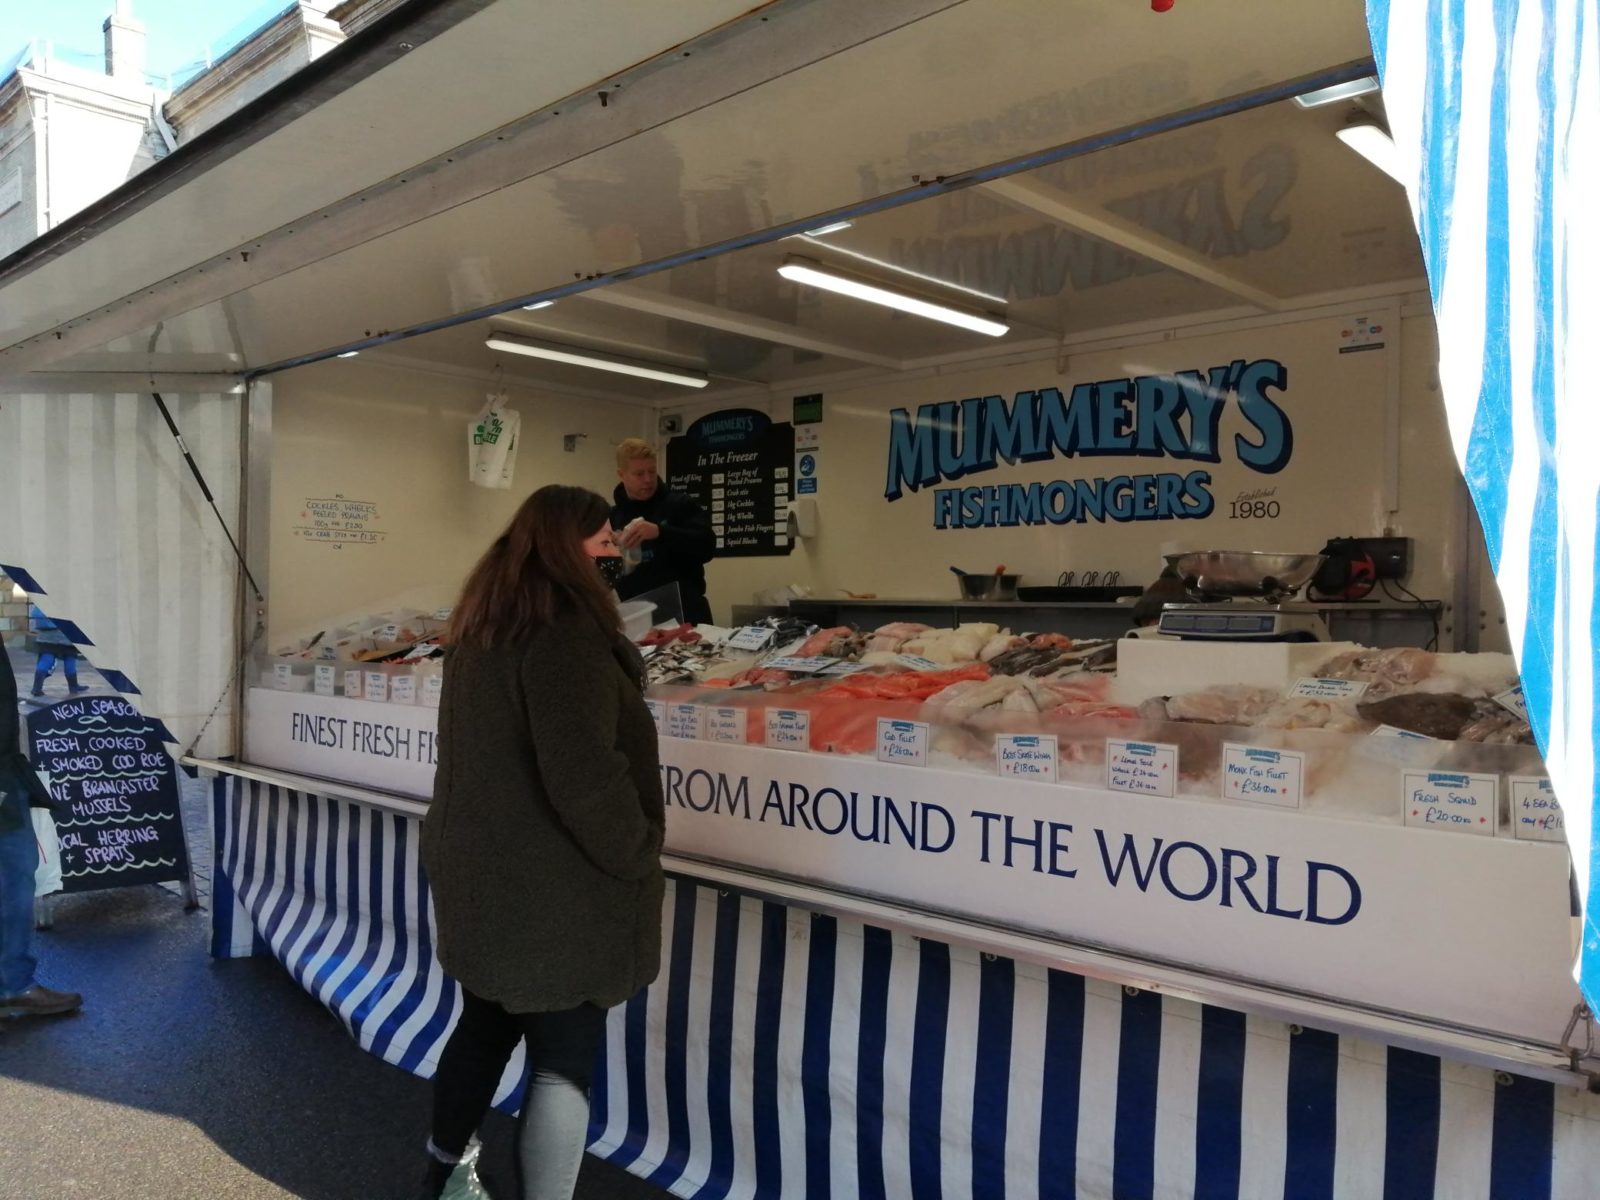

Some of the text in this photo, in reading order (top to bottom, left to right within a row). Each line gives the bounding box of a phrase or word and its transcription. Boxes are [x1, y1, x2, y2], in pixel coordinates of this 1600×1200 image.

[702, 415, 753, 436] MUMMERY'S
[884, 358, 1293, 503] MUMMERY'S
[697, 451, 759, 466] In The Freezer
[933, 470, 1215, 530] FISHMONGERS
[1229, 500, 1280, 519] 1980
[51, 701, 85, 721] NEW
[89, 737, 146, 752] COOKED
[291, 712, 348, 749] FINEST
[352, 720, 411, 761] FRESH
[899, 732, 916, 743] FILLET
[51, 755, 103, 773] SMOKED
[112, 754, 136, 770] COD
[141, 752, 167, 768] ROE
[82, 776, 160, 798] BRANCASTER
[1413, 789, 1439, 804] FRESH
[71, 795, 132, 816] MUSSELS
[97, 825, 160, 846] HERRING
[659, 764, 1362, 926] ROM AROUND THE WORLD
[85, 842, 136, 865] SPRATS
